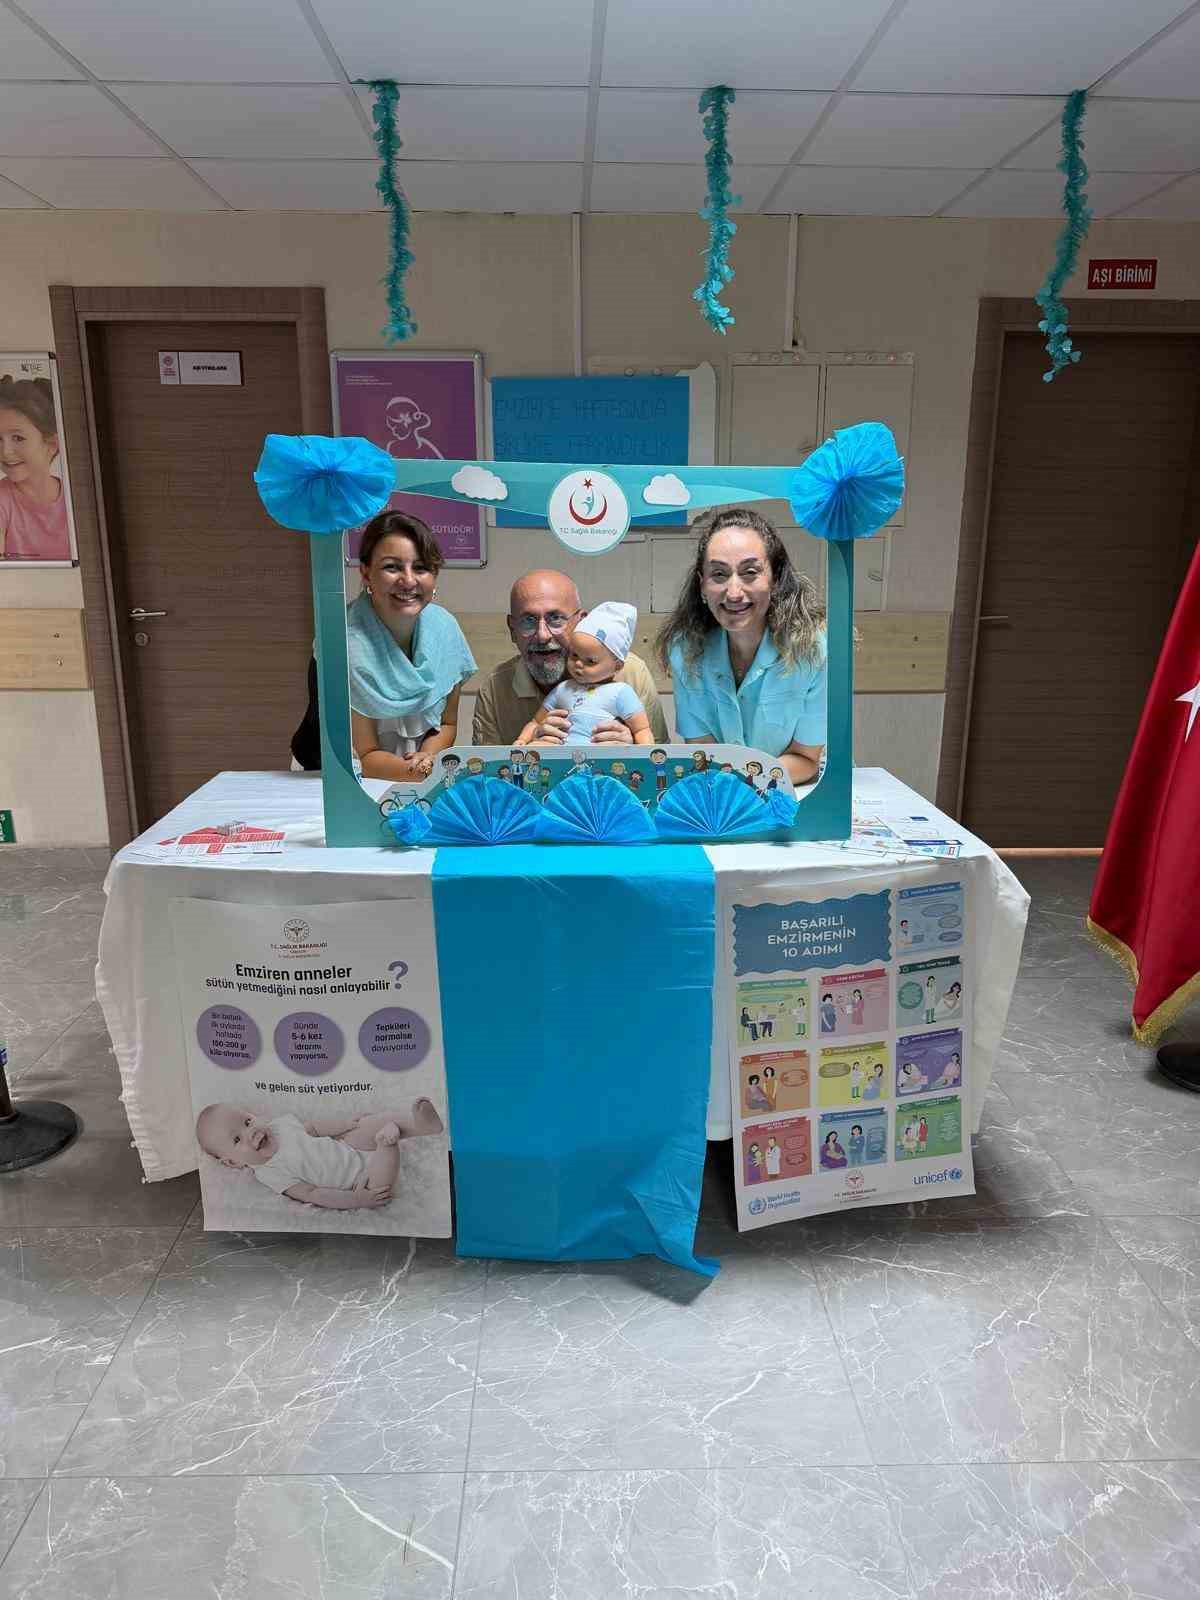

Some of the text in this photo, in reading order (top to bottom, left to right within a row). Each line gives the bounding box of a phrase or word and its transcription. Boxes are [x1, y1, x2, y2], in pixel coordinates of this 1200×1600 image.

[1092, 264, 1153, 287] AŞI BİRİMİ
[781, 914, 844, 931] BAŞARILI
[767, 926, 856, 945] EMZİRMENİN
[782, 943, 842, 958] 10 ADIMI
[235, 964, 353, 981] Emziren anneler
[206, 977, 234, 989] sütün
[236, 981, 297, 998] yetmediğini
[300, 984, 327, 996] nasıl
[330, 980, 391, 994] anlayabilir
[308, 1032, 322, 1040] kez
[254, 1081, 373, 1095] ve gelen süt yetiyordur.
[913, 1169, 948, 1185] unicef
